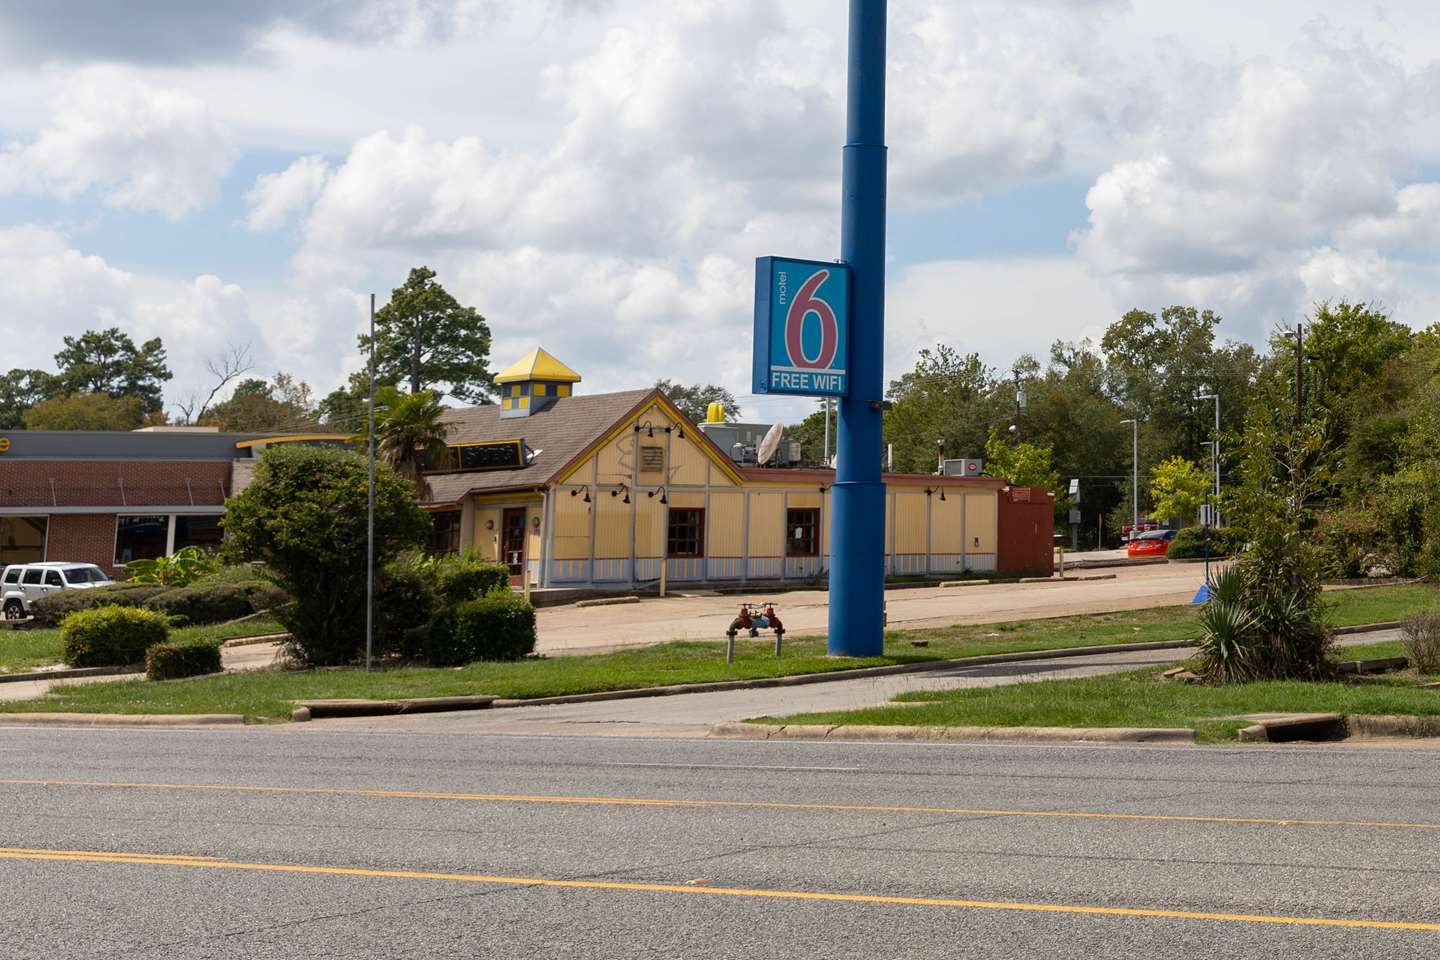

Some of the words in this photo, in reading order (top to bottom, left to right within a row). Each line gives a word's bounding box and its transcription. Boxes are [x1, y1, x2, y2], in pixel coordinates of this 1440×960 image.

[785, 268, 838, 369] 6
[771, 372, 809, 389] FREE
[812, 375, 841, 391] WIFI
